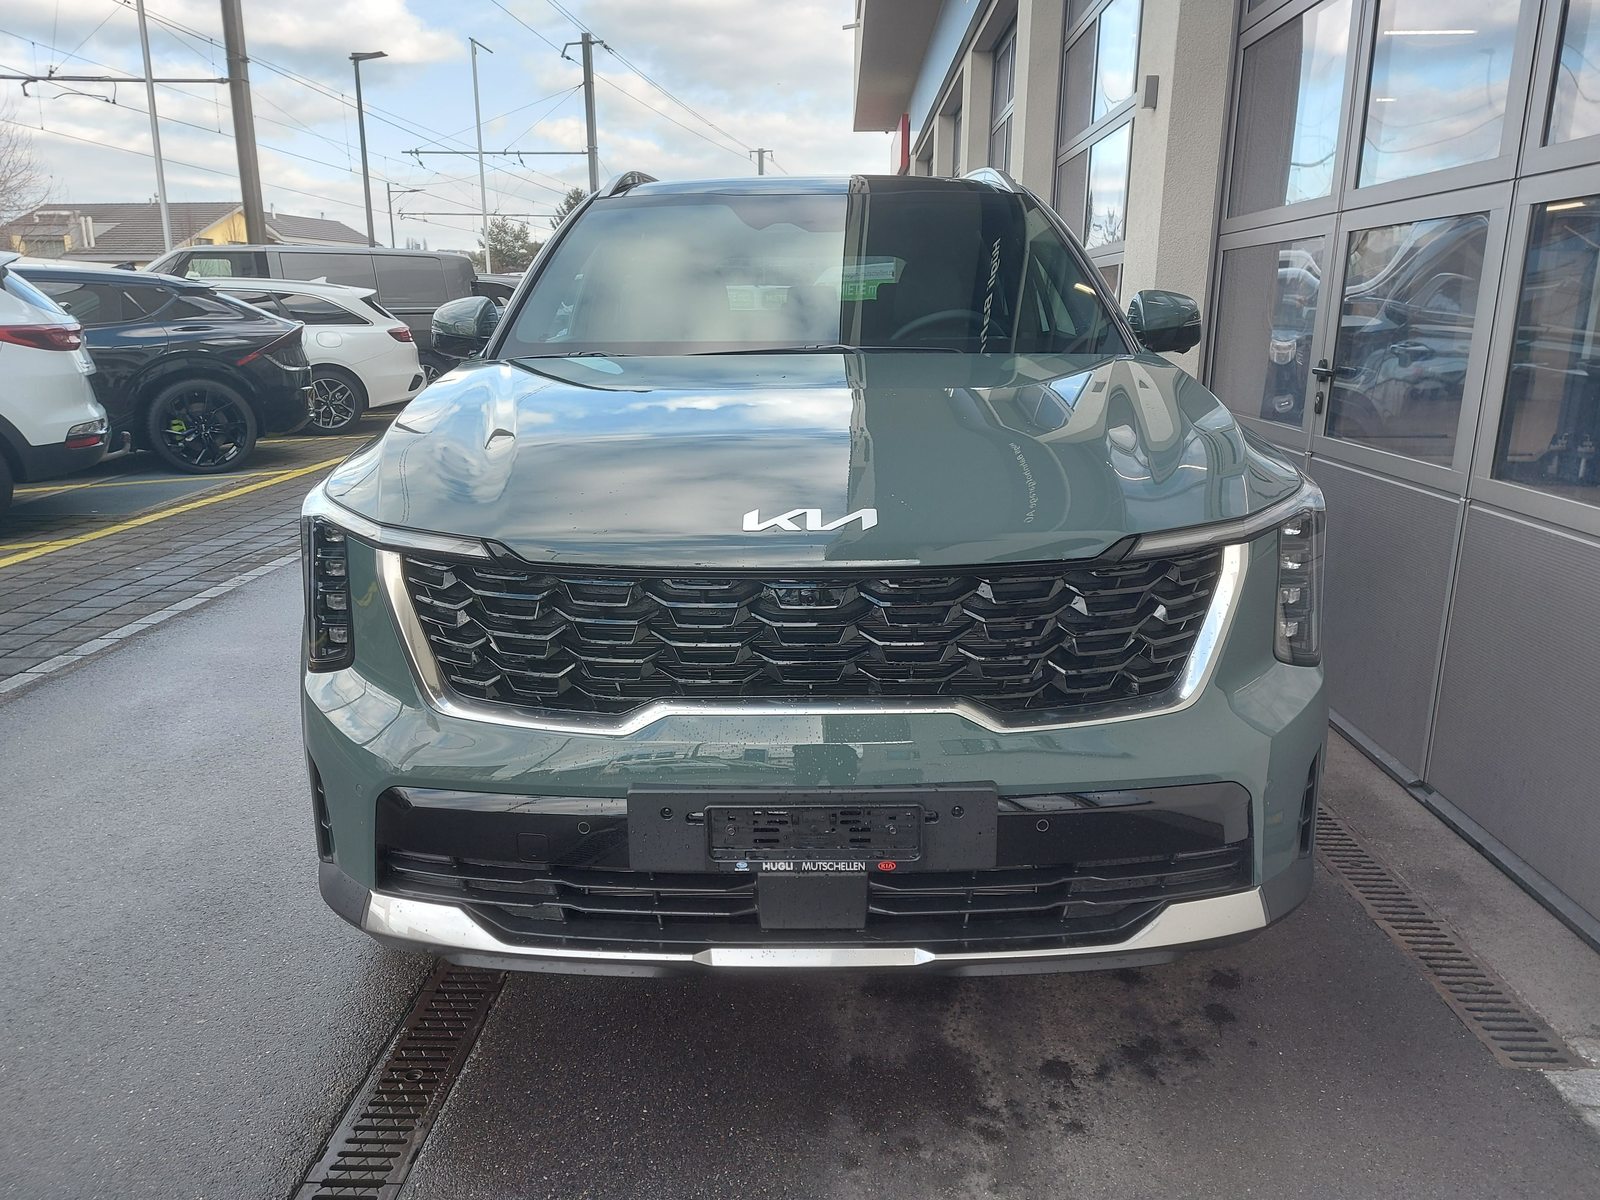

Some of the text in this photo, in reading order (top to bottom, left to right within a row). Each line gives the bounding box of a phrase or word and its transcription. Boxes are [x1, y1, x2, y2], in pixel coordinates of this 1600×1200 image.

[743, 508, 877, 531] KIA
[801, 862, 866, 871] MUTSCHELLEN
[879, 862, 895, 870] KIA
